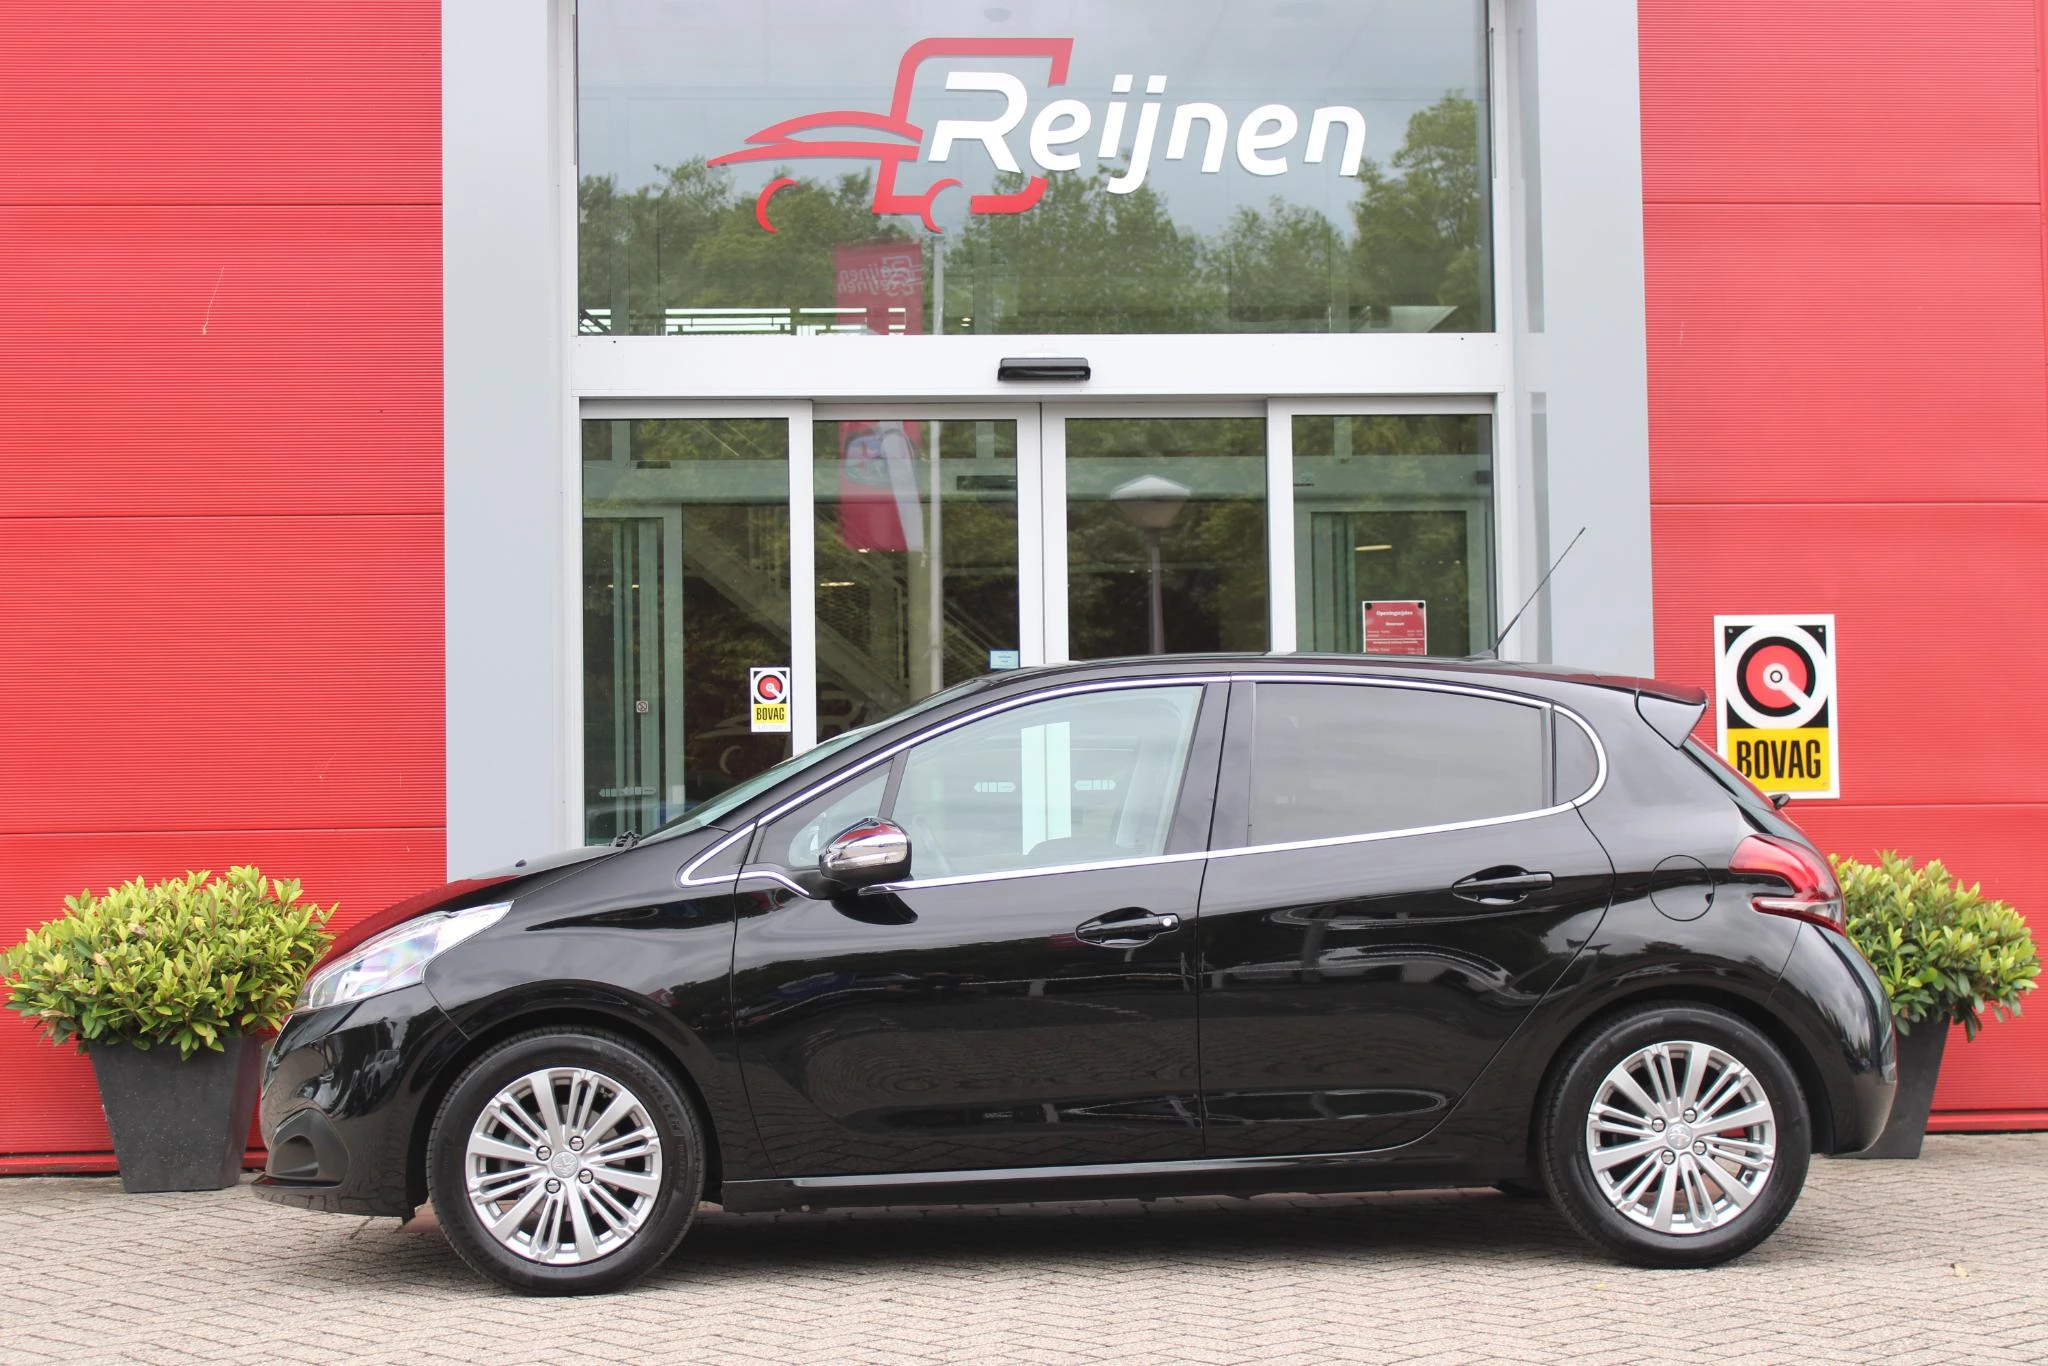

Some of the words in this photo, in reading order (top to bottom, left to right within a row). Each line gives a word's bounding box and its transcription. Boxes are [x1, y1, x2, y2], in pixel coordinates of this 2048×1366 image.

[927, 71, 1367, 195] Reijnen
[756, 707, 785, 721] BOVAG
[1737, 739, 1821, 779] BOVAG
